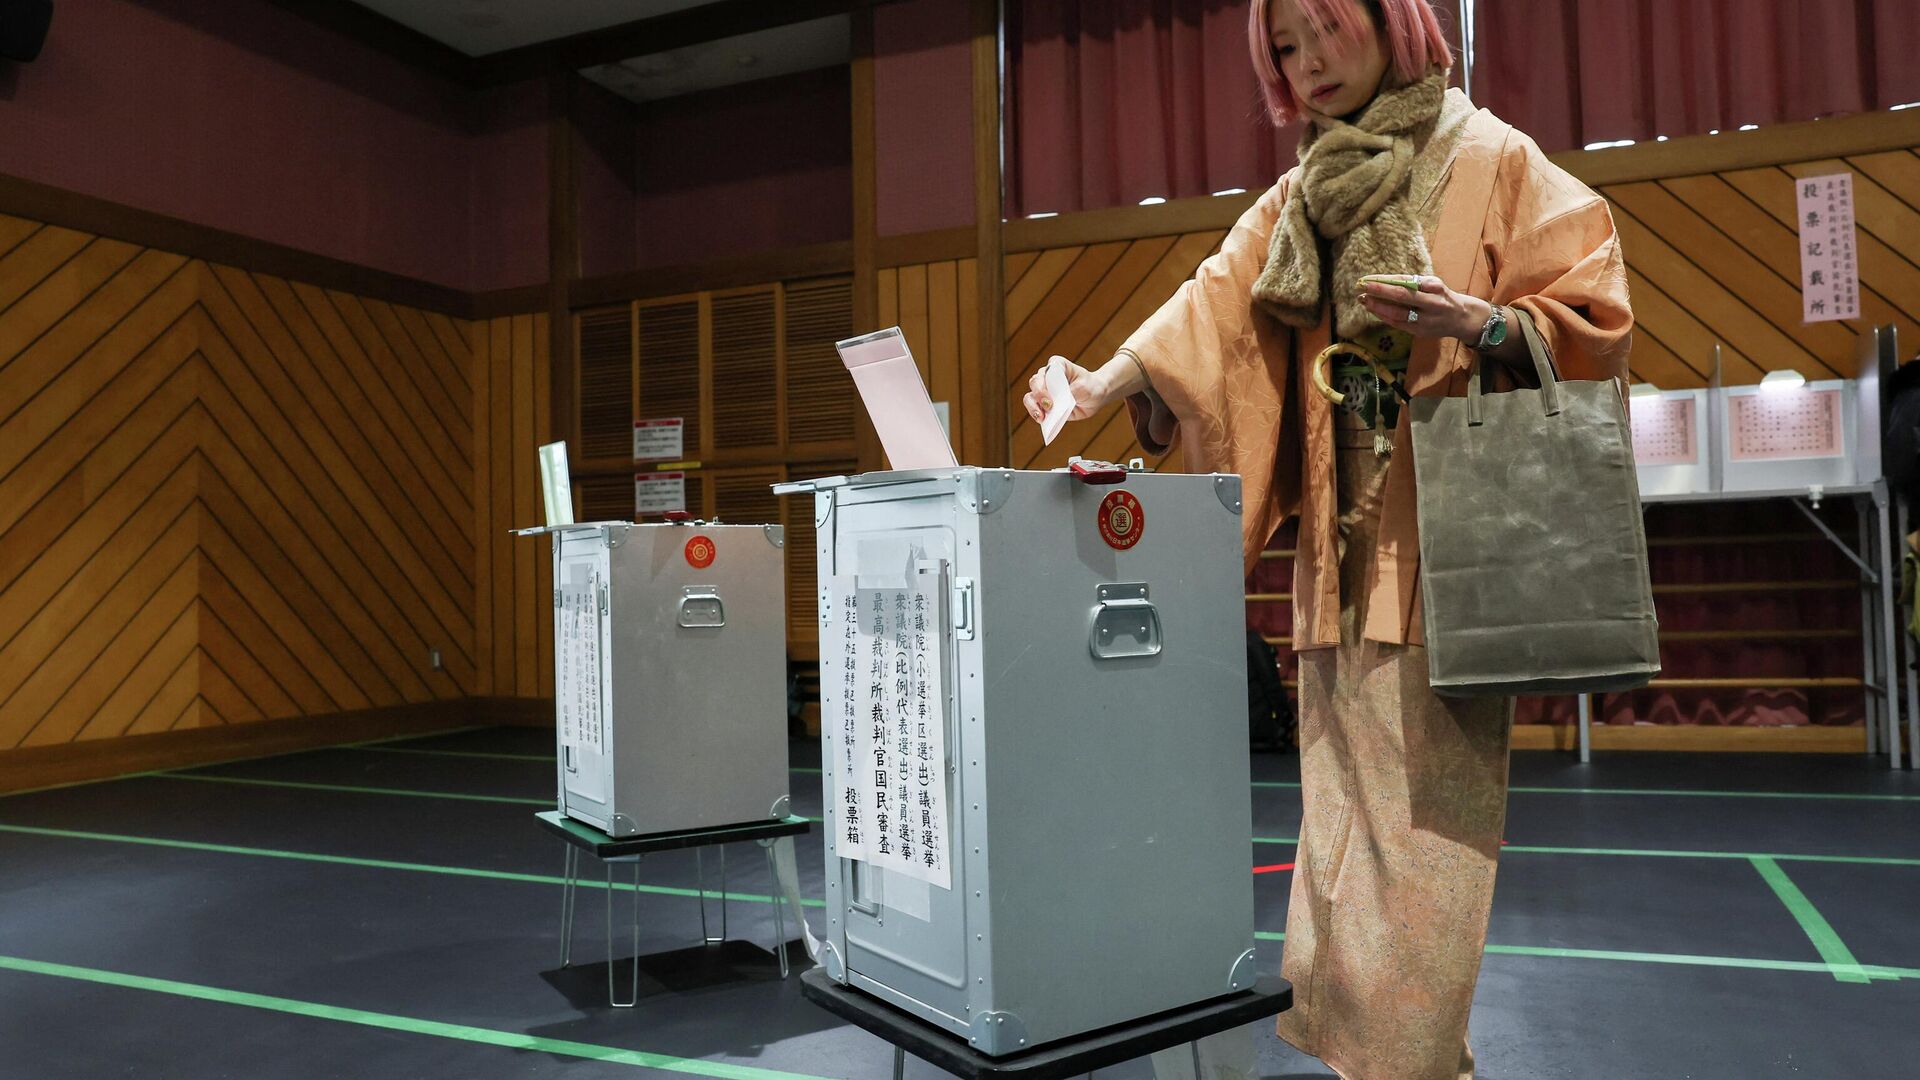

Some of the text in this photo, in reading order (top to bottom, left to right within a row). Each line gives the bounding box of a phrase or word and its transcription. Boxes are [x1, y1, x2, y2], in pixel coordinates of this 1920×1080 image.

[1803, 183, 1825, 315] 投票記載所
[844, 787, 859, 845] 投票箱
[870, 592, 890, 855] 最高裁判所裁判官国民審査
[895, 592, 912, 861] 衆議院（比例代表選出）議員選挙
[915, 592, 935, 869] 衆議院（小選挙区選出）議員選挙
